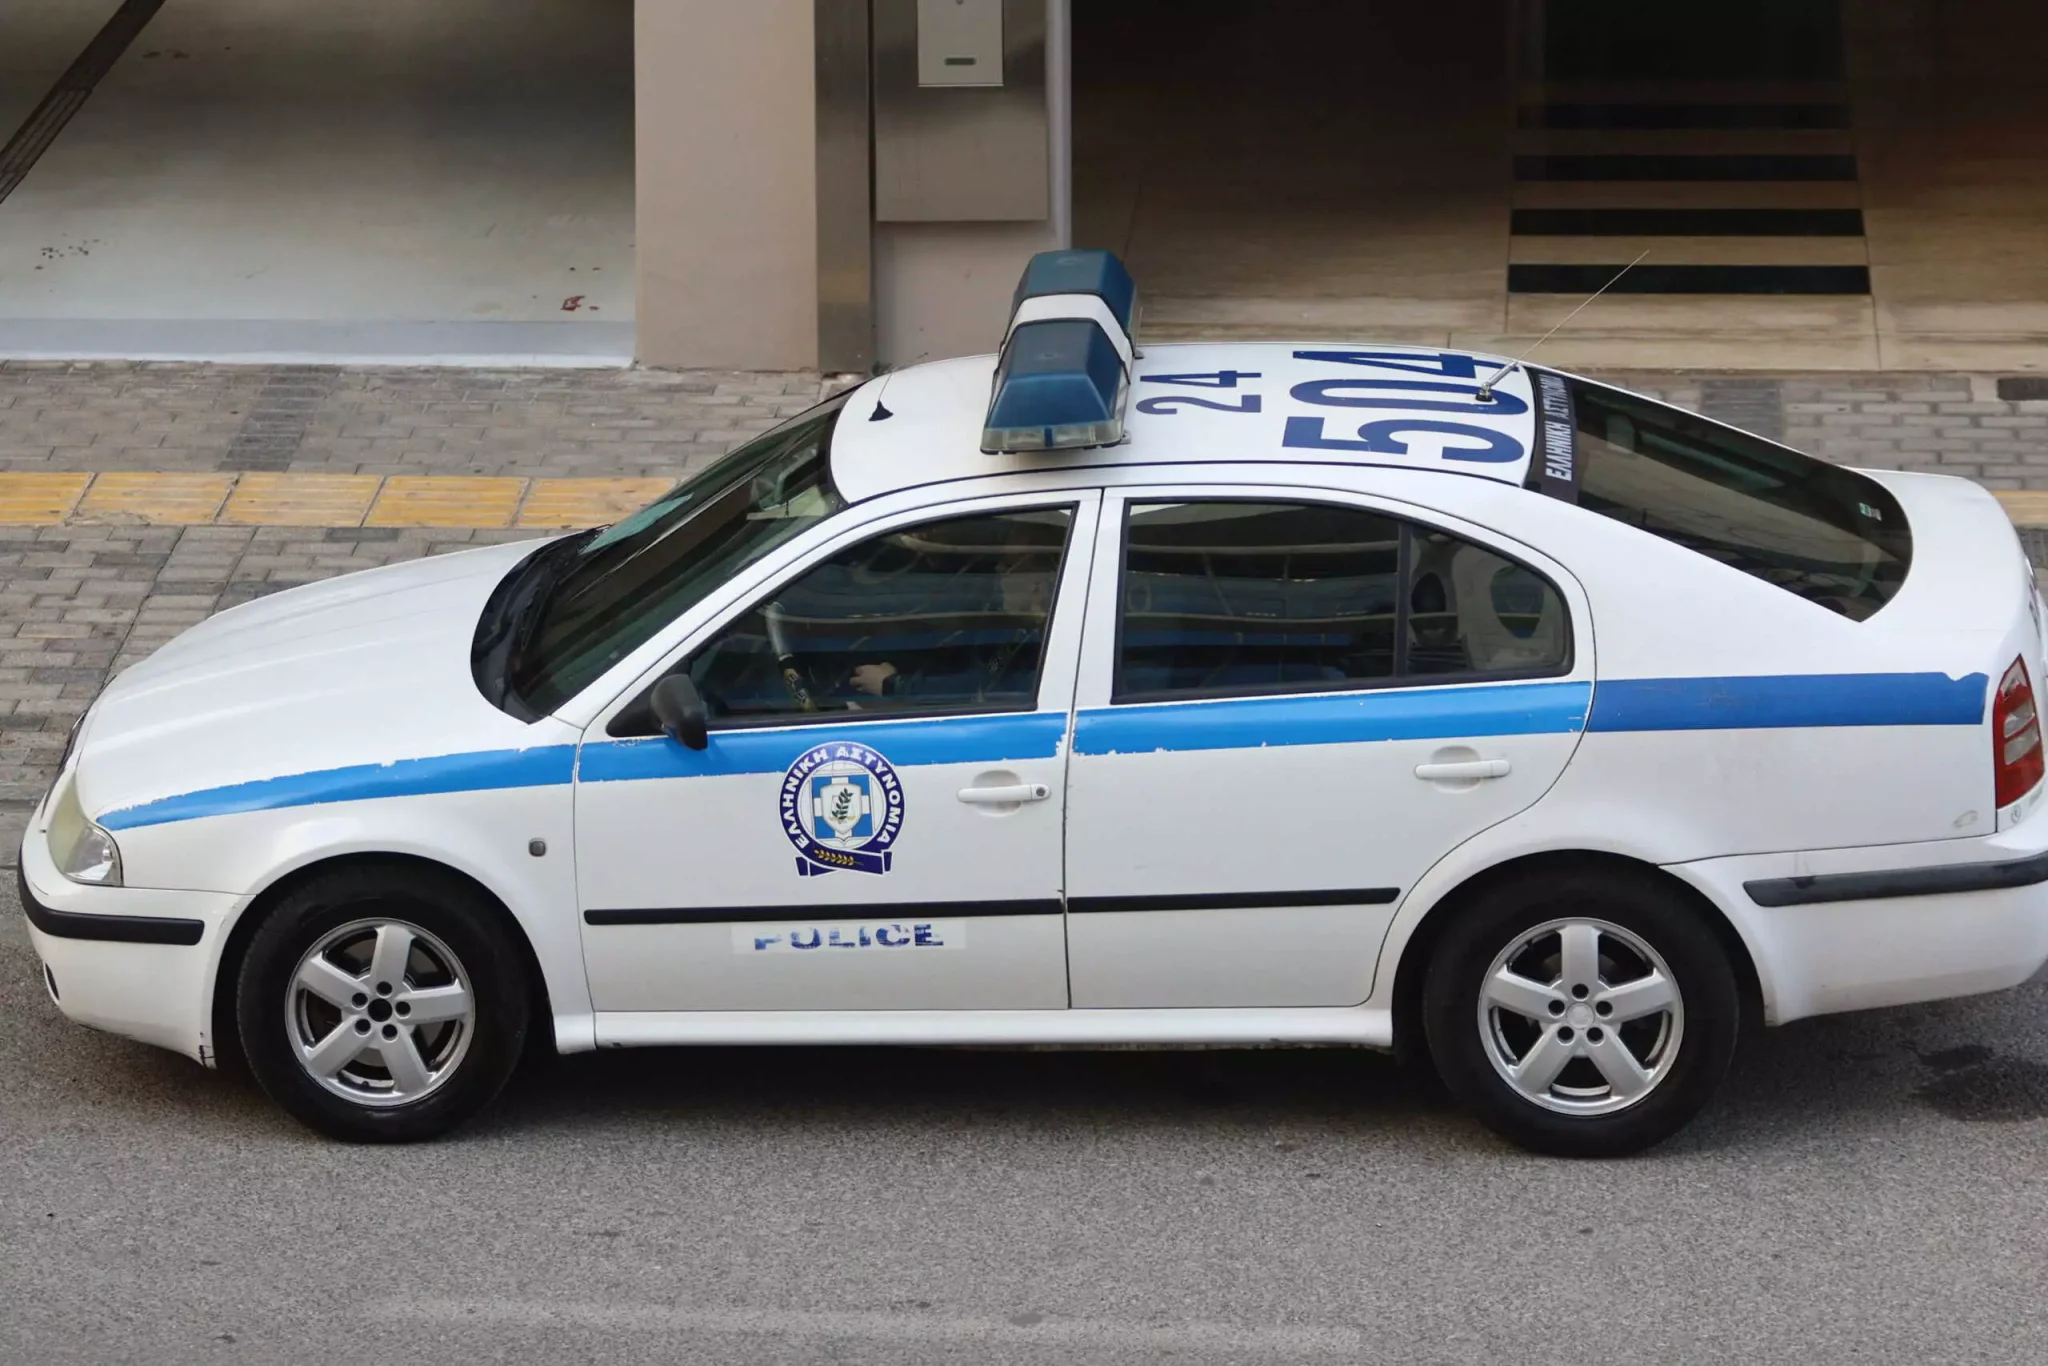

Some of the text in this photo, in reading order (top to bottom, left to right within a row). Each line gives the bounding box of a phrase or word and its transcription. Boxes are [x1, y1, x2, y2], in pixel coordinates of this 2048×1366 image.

[1136, 370, 1262, 415] 24
[1282, 350, 1529, 463] 504
[1545, 421, 1572, 481] ΕΛΛΗΝΙΚΗ
[782, 746, 902, 849] ΕΛΛΗΝΙΚΗ ΑΣΤΥΝΟΜΙΑ
